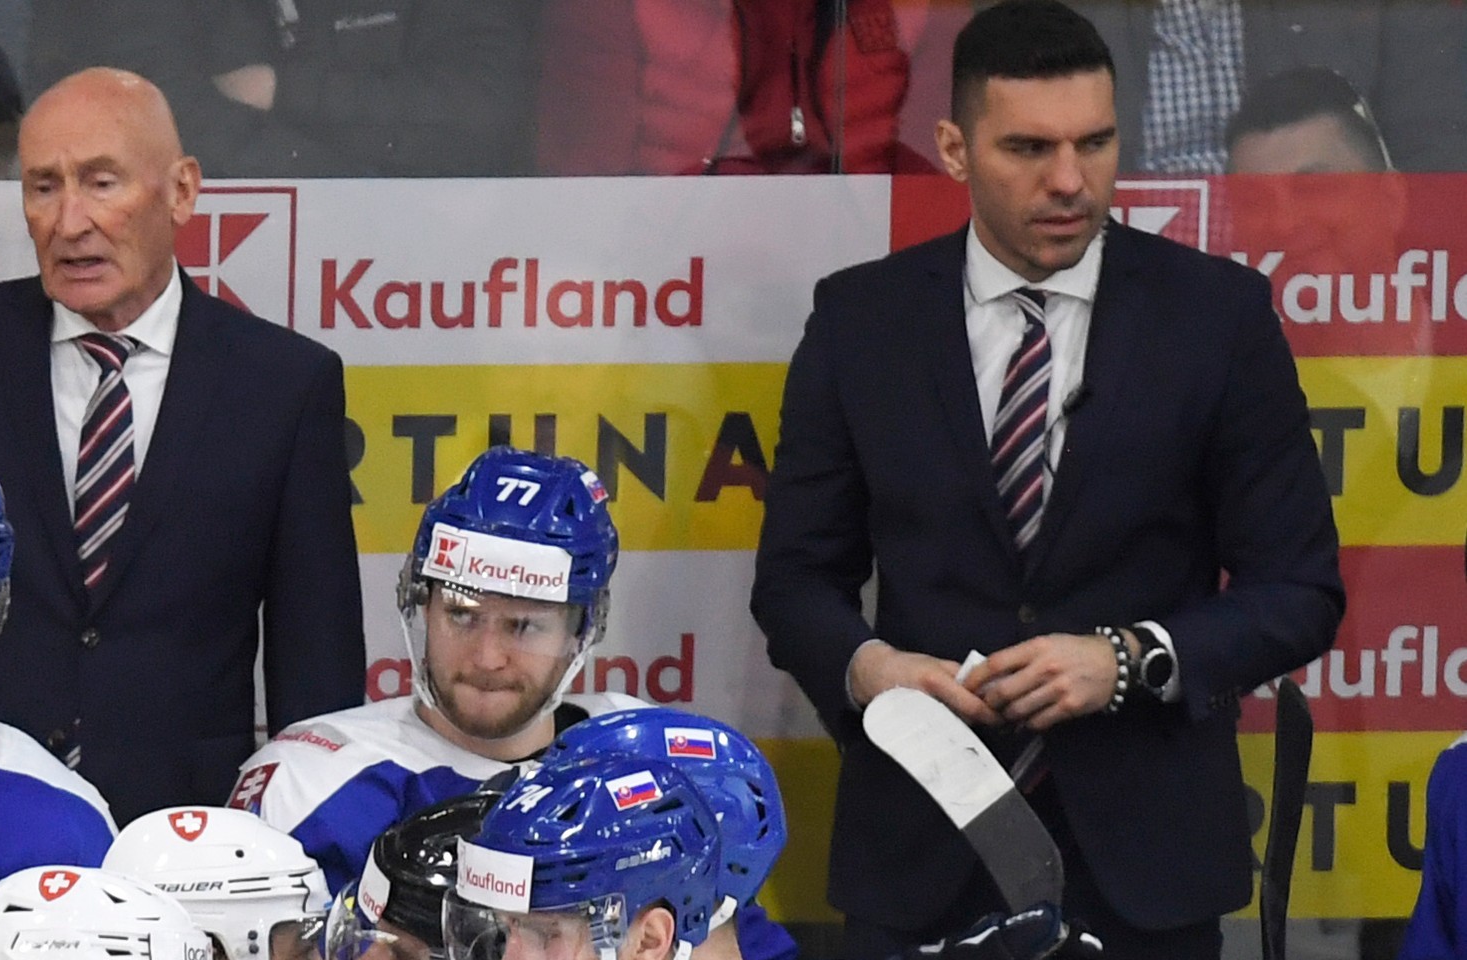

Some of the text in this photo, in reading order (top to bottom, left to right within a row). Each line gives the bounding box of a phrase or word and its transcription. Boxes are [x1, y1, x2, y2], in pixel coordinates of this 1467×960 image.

[319, 257, 705, 330] Kaufland
[1231, 250, 1467, 324] aufl
[495, 476, 542, 507] 77
[468, 555, 565, 589] Kaufland
[466, 869, 527, 899] Kaufland
